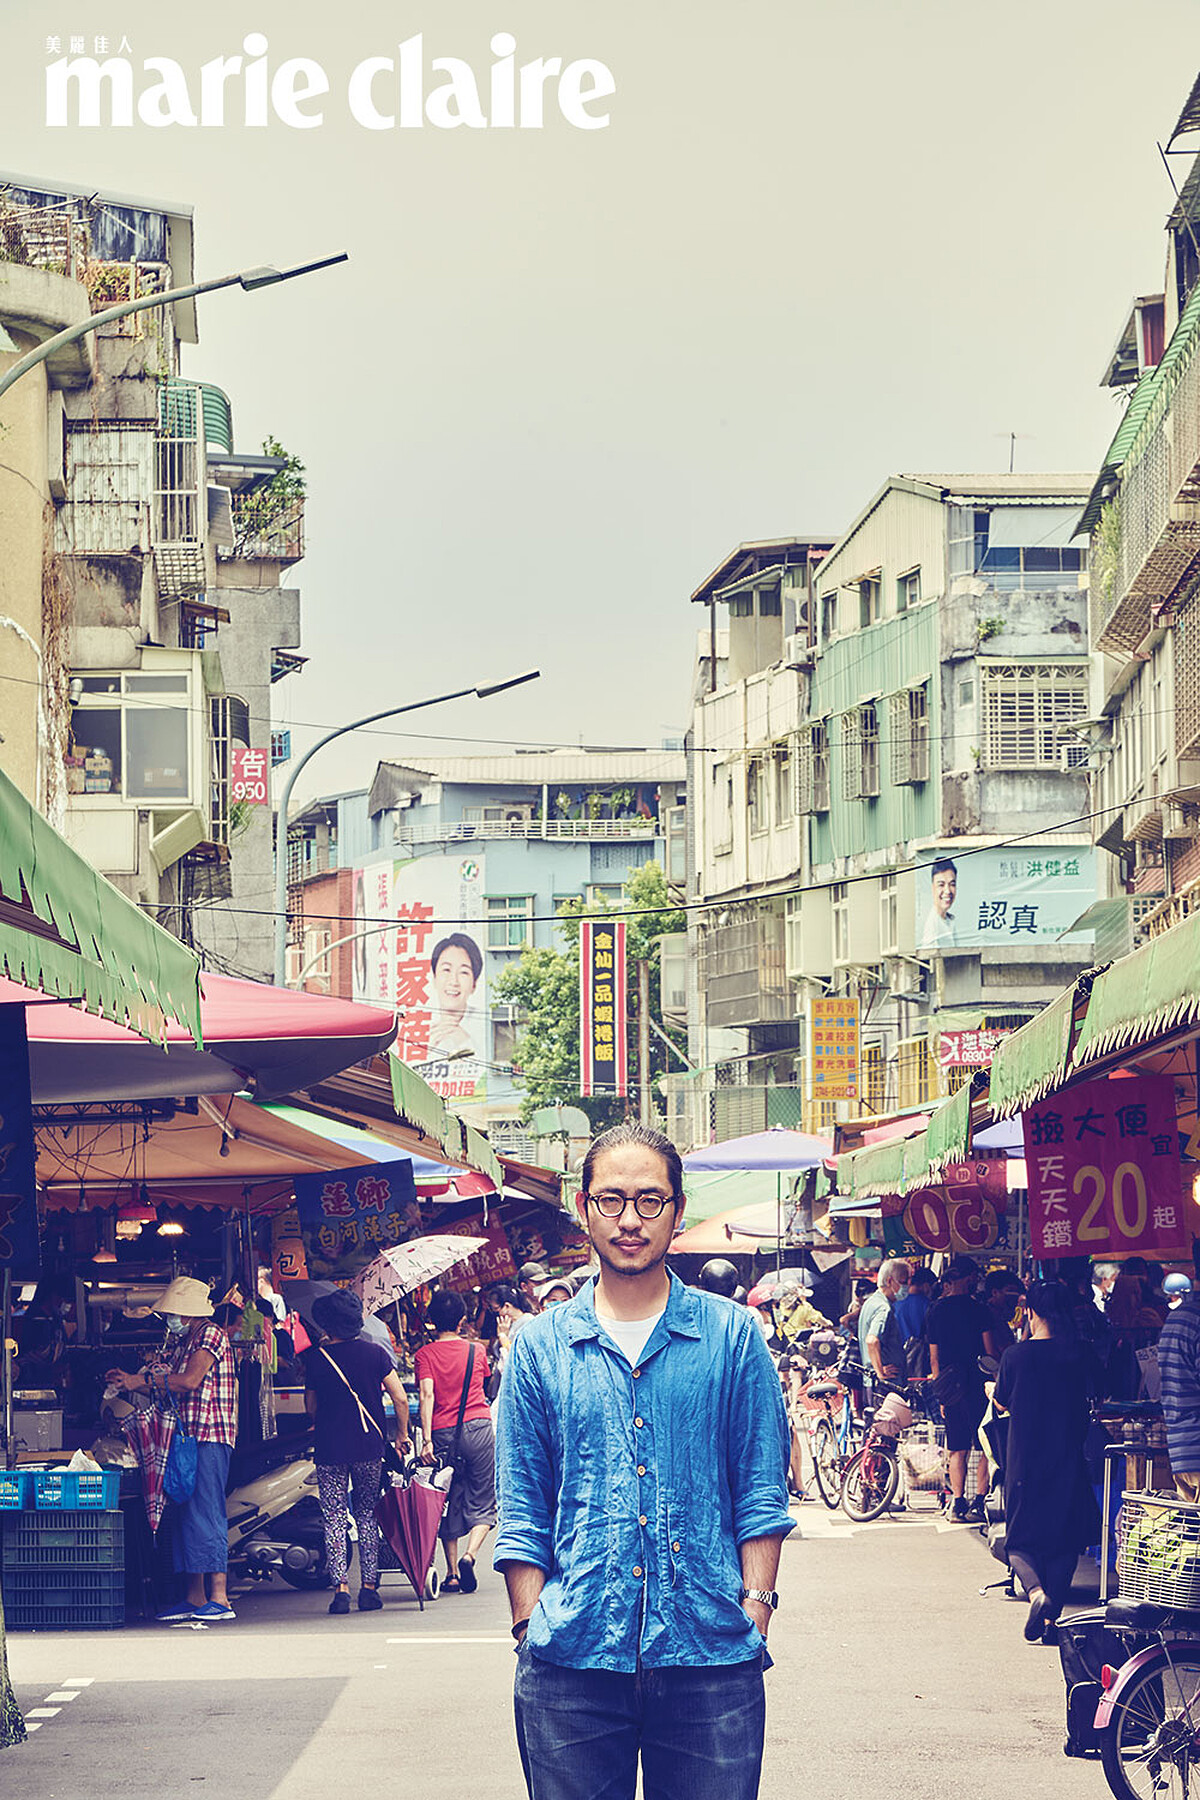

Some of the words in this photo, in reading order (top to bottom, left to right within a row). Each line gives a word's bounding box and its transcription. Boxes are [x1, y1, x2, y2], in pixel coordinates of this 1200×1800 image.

[231, 750, 266, 778] 告
[1027, 858, 1080, 877] 洪健益
[978, 900, 1039, 935] 認真
[1073, 1161, 1148, 1243] 20
[1153, 1205, 1178, 1230] 起
